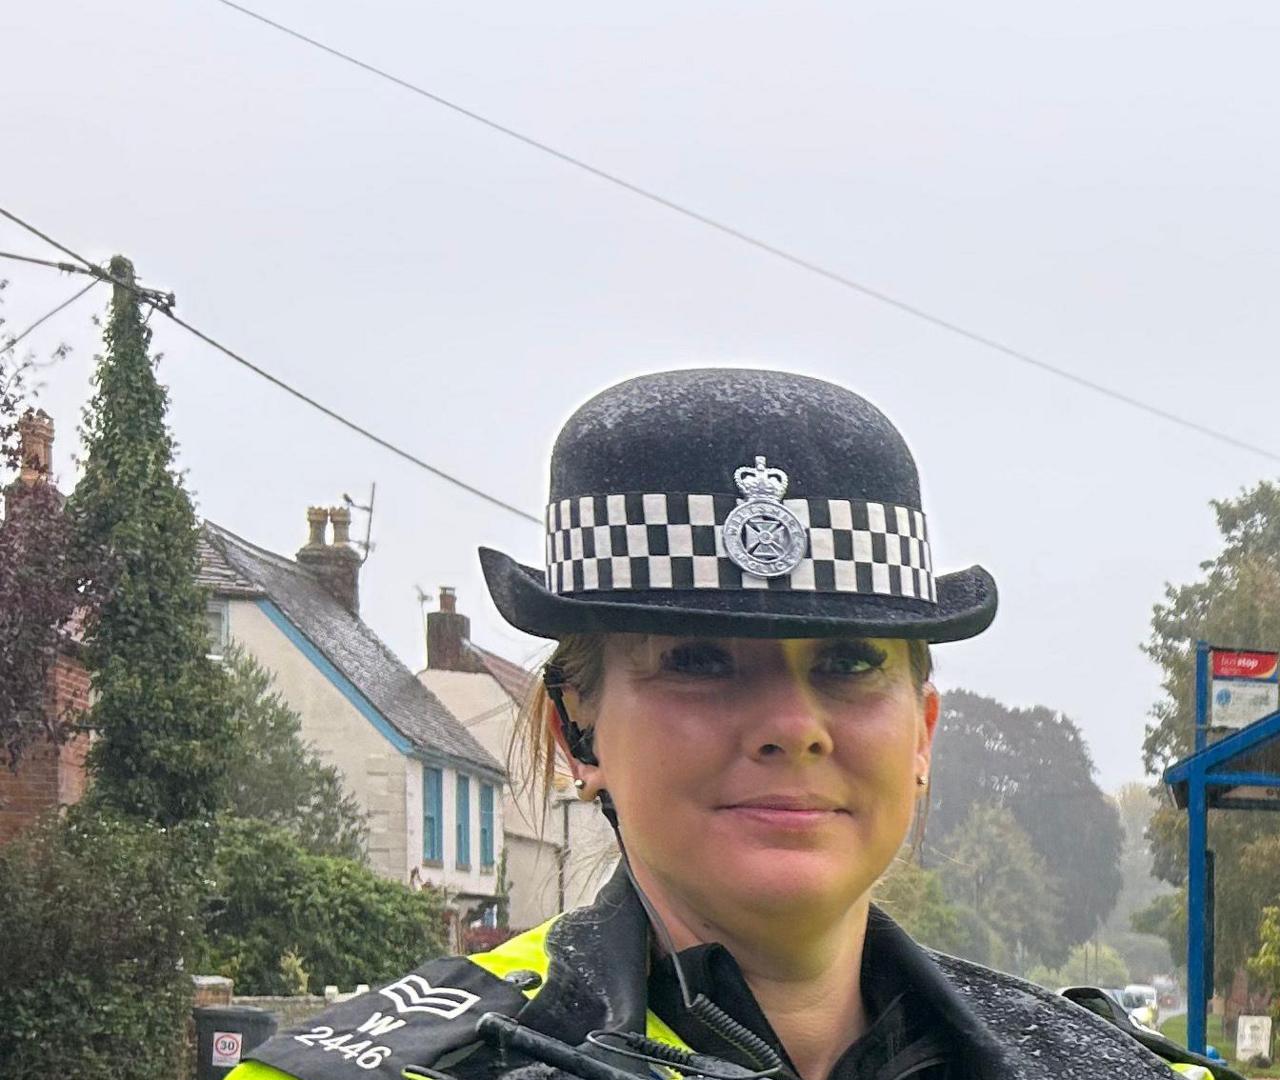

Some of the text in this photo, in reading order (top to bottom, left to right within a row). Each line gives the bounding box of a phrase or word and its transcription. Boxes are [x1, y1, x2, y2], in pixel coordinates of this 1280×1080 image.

[1237, 657, 1259, 670] stop
[357, 1012, 406, 1036] W
[220, 1040, 235, 1051] 30
[294, 1026, 392, 1070] 2446
